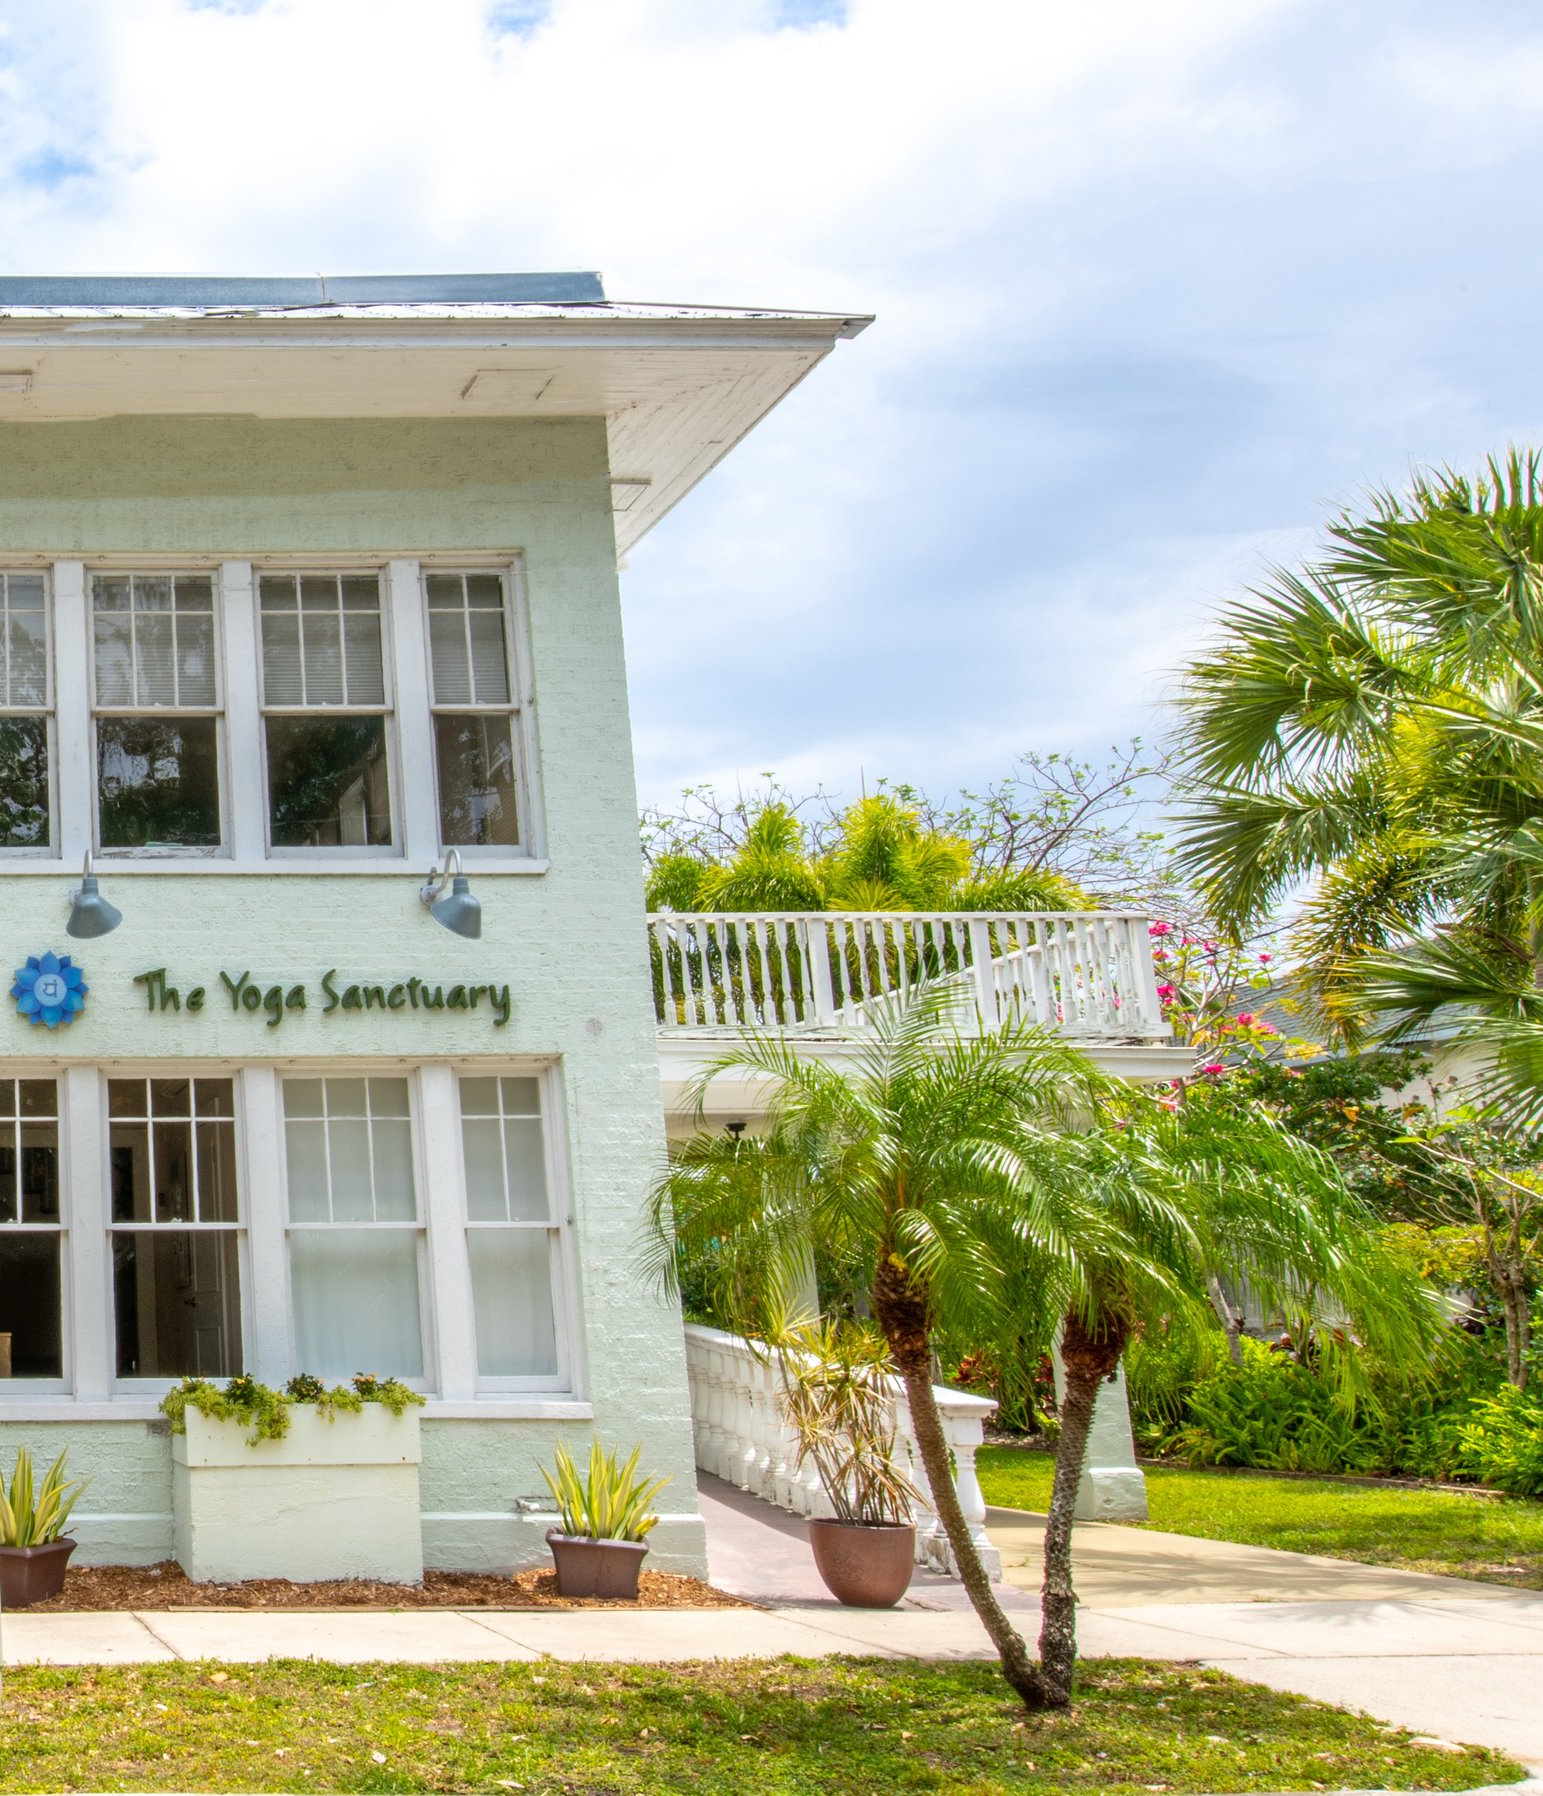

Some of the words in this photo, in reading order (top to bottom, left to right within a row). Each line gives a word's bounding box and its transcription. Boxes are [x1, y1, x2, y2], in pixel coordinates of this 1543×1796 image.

[133, 967, 206, 1012] The
[219, 970, 307, 1027] Yoga
[321, 968, 511, 1027] Sanctuary
